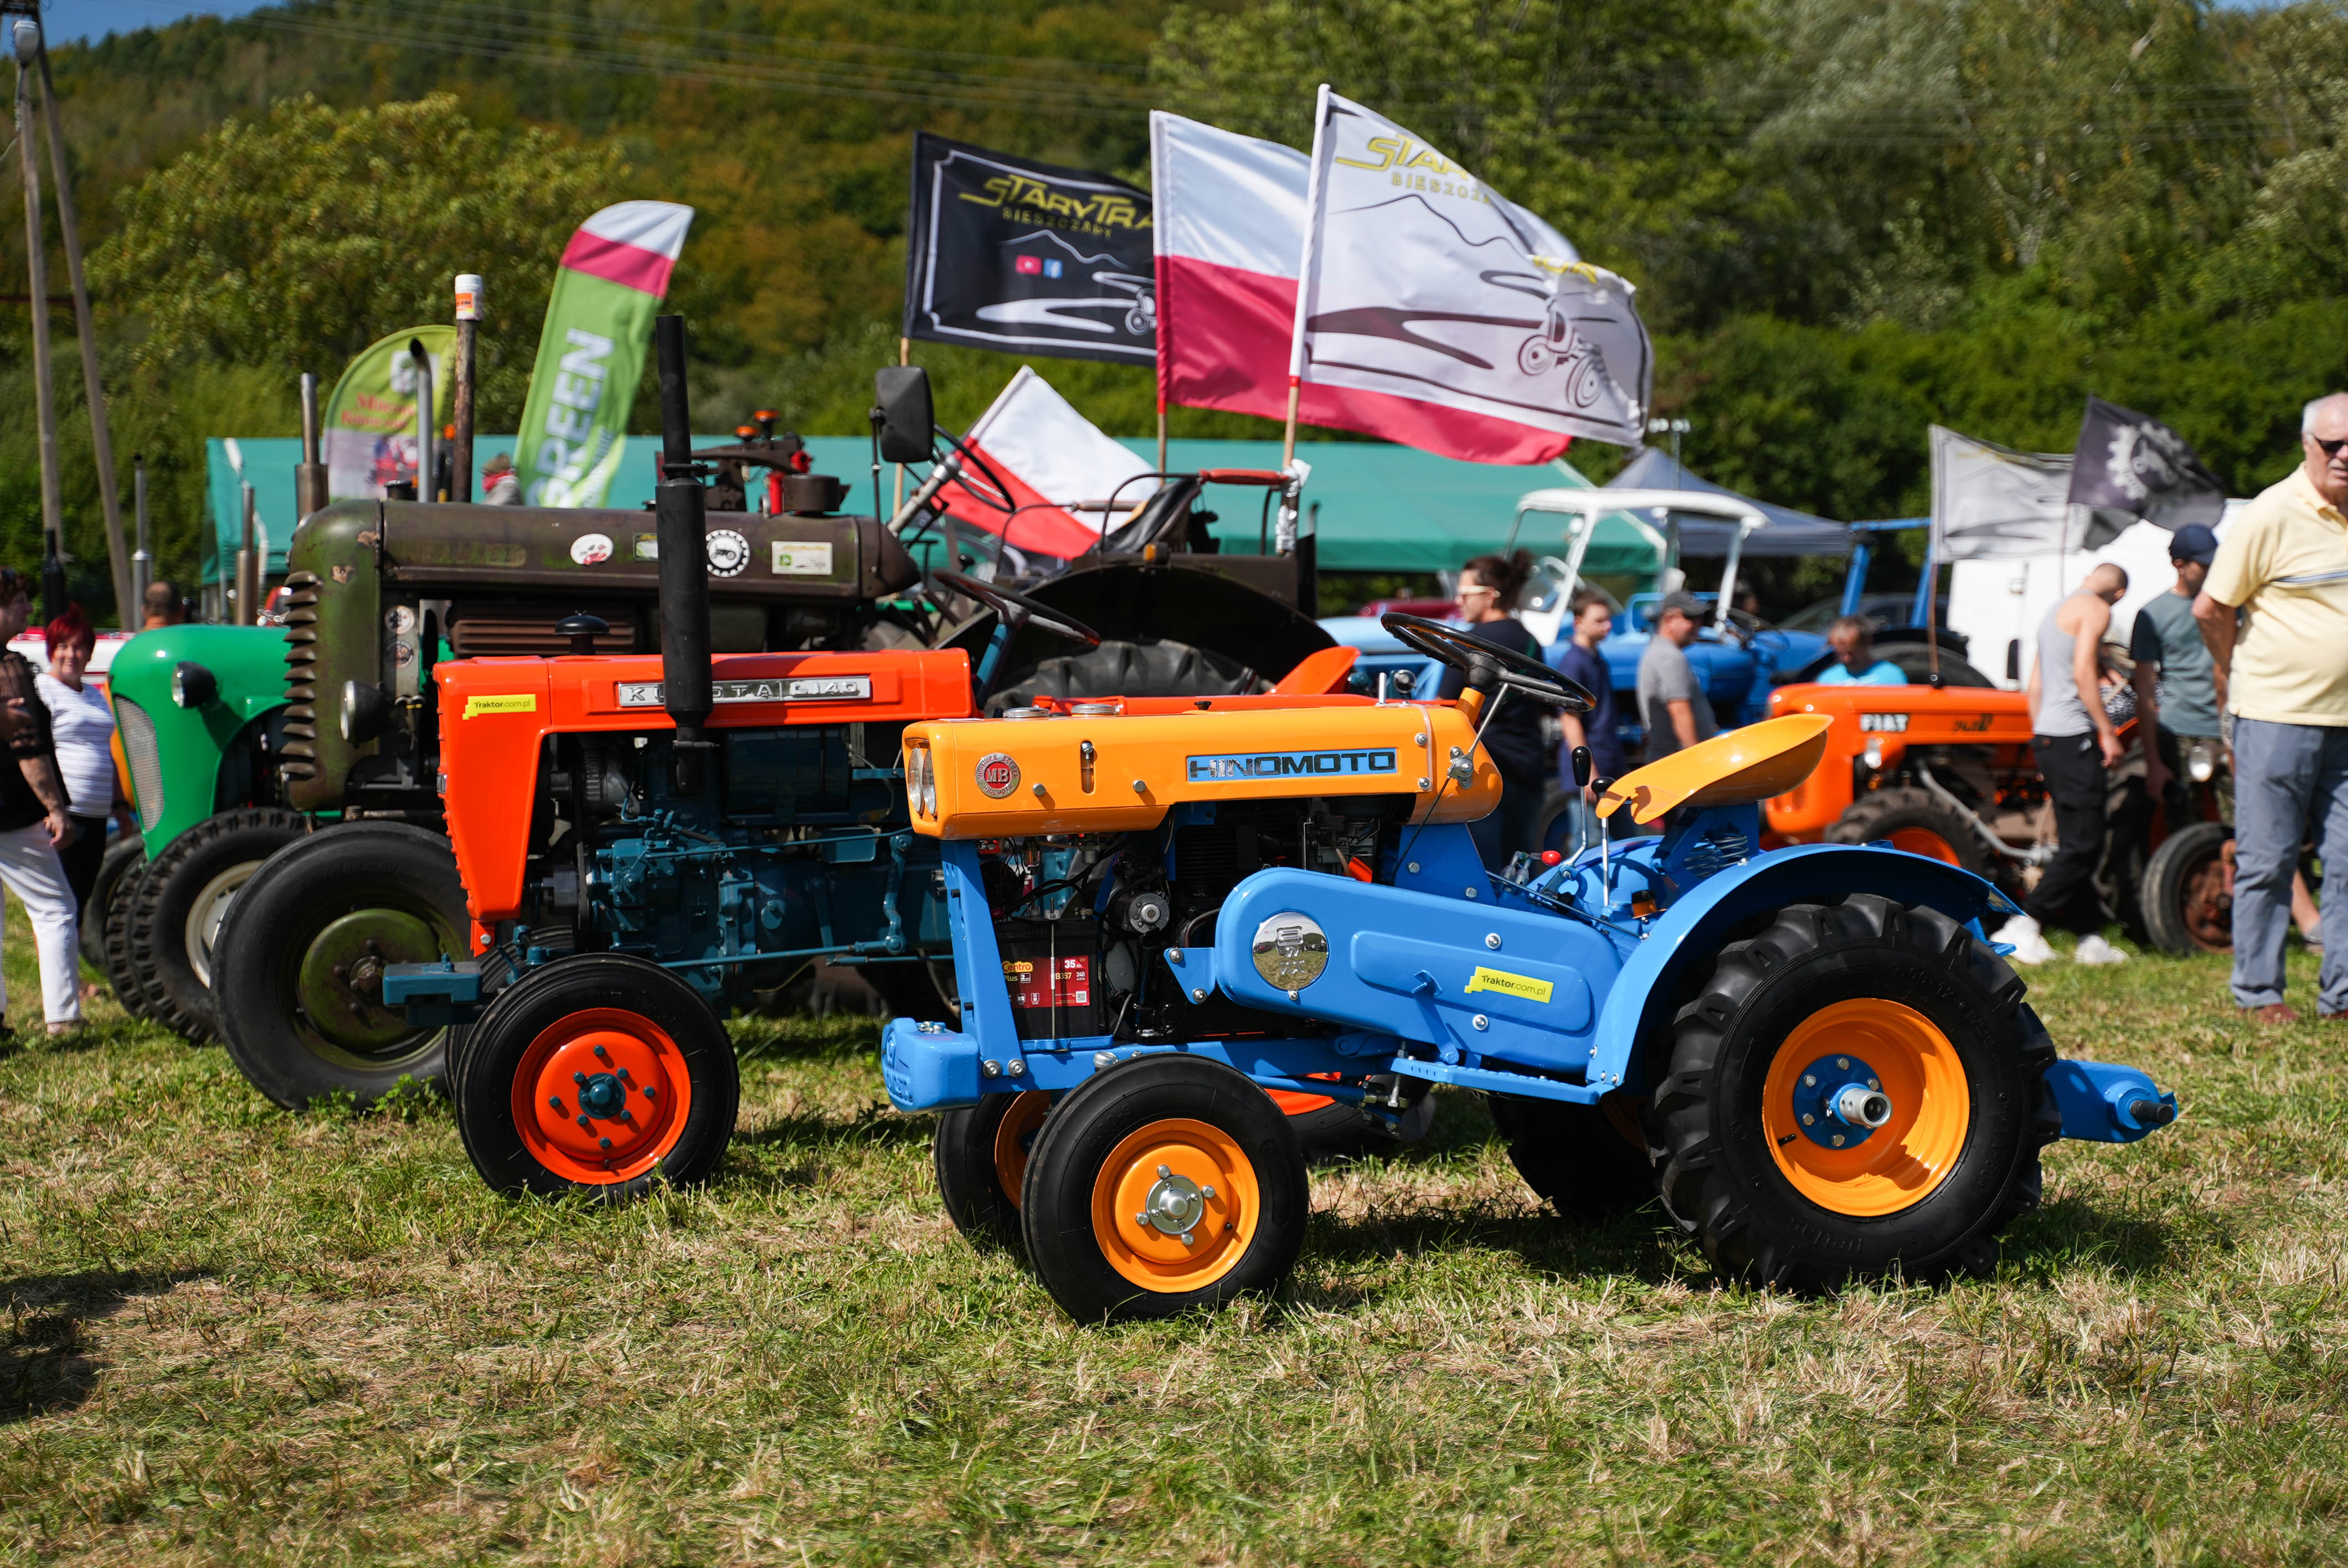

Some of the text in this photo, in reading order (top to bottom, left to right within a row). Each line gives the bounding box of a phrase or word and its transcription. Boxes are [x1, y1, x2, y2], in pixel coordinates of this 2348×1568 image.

[629, 682, 774, 702] KUOTA
[474, 700, 530, 708] Traktor.com.pl
[1860, 713, 1909, 732] FIAT
[1190, 751, 1396, 778] HINOMOTO
[987, 768, 1009, 782] MB
[1002, 962, 1032, 972] Centra
[1064, 960, 1075, 968] 35
[1482, 975, 1546, 996] Traktor.com.pl
